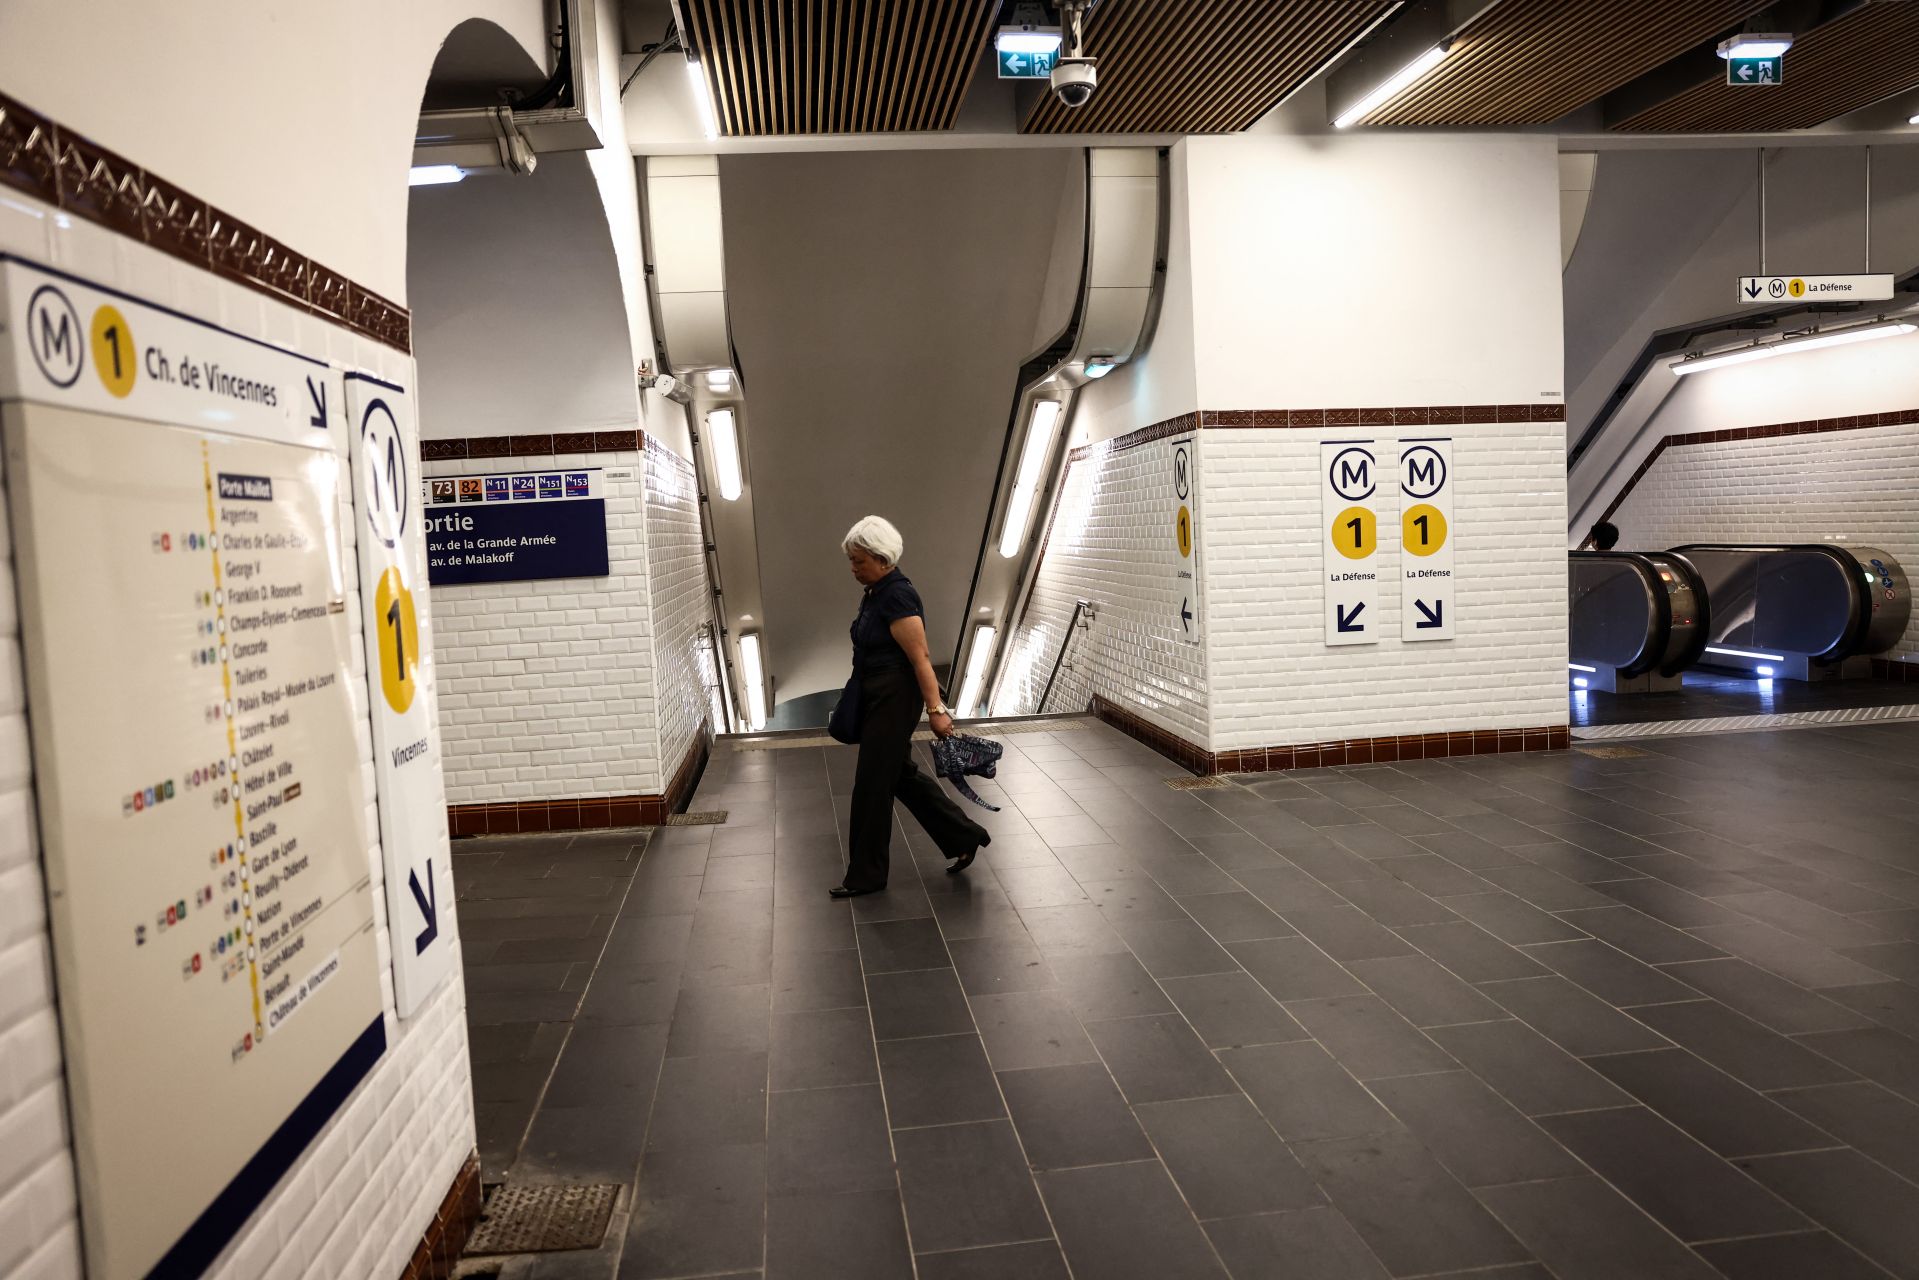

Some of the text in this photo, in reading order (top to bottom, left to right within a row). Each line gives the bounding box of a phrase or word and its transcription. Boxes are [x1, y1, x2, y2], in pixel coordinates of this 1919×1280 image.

[1772, 282, 1852, 294] M 1 La Défense
[39, 306, 278, 408] M 1 Ch. de Vincennes
[1177, 459, 1187, 489] M
[1341, 459, 1368, 489] M
[1408, 457, 1435, 487] M
[220, 478, 243, 497] Porte
[434, 481, 453, 495] 73
[461, 480, 480, 493] 82
[221, 506, 259, 527] Argentine
[423, 512, 474, 533] ortie
[223, 533, 252, 550] Charles
[1180, 517, 1187, 547] 1
[1346, 517, 1362, 548] 1
[1413, 514, 1429, 545] 1
[429, 534, 557, 552] av. de la Grande Armée
[225, 560, 254, 580] George
[431, 552, 514, 567] av. de Malakoff
[1330, 572, 1376, 582] La Défense
[1406, 568, 1451, 578] La Défense
[228, 587, 260, 605] Franklin
[270, 583, 303, 600] Roosevelt
[232, 638, 268, 659] Concorde
[386, 598, 405, 681] 1
[236, 667, 267, 686] Tuileries
[237, 696, 260, 713] Palais
[242, 743, 273, 768] Châtelet
[391, 737, 428, 769] Vincennes
[244, 770, 266, 794] Hôtel
[276, 760, 293, 778] Ville
[249, 822, 278, 849] Bastille
[252, 854, 270, 875] Gare
[281, 838, 297, 857] Lyon
[257, 900, 281, 927] Nation
[259, 929, 279, 953] Porte
[289, 895, 322, 928] Vincennes
[269, 994, 298, 1028] Château
[307, 958, 337, 992] Vincennes
